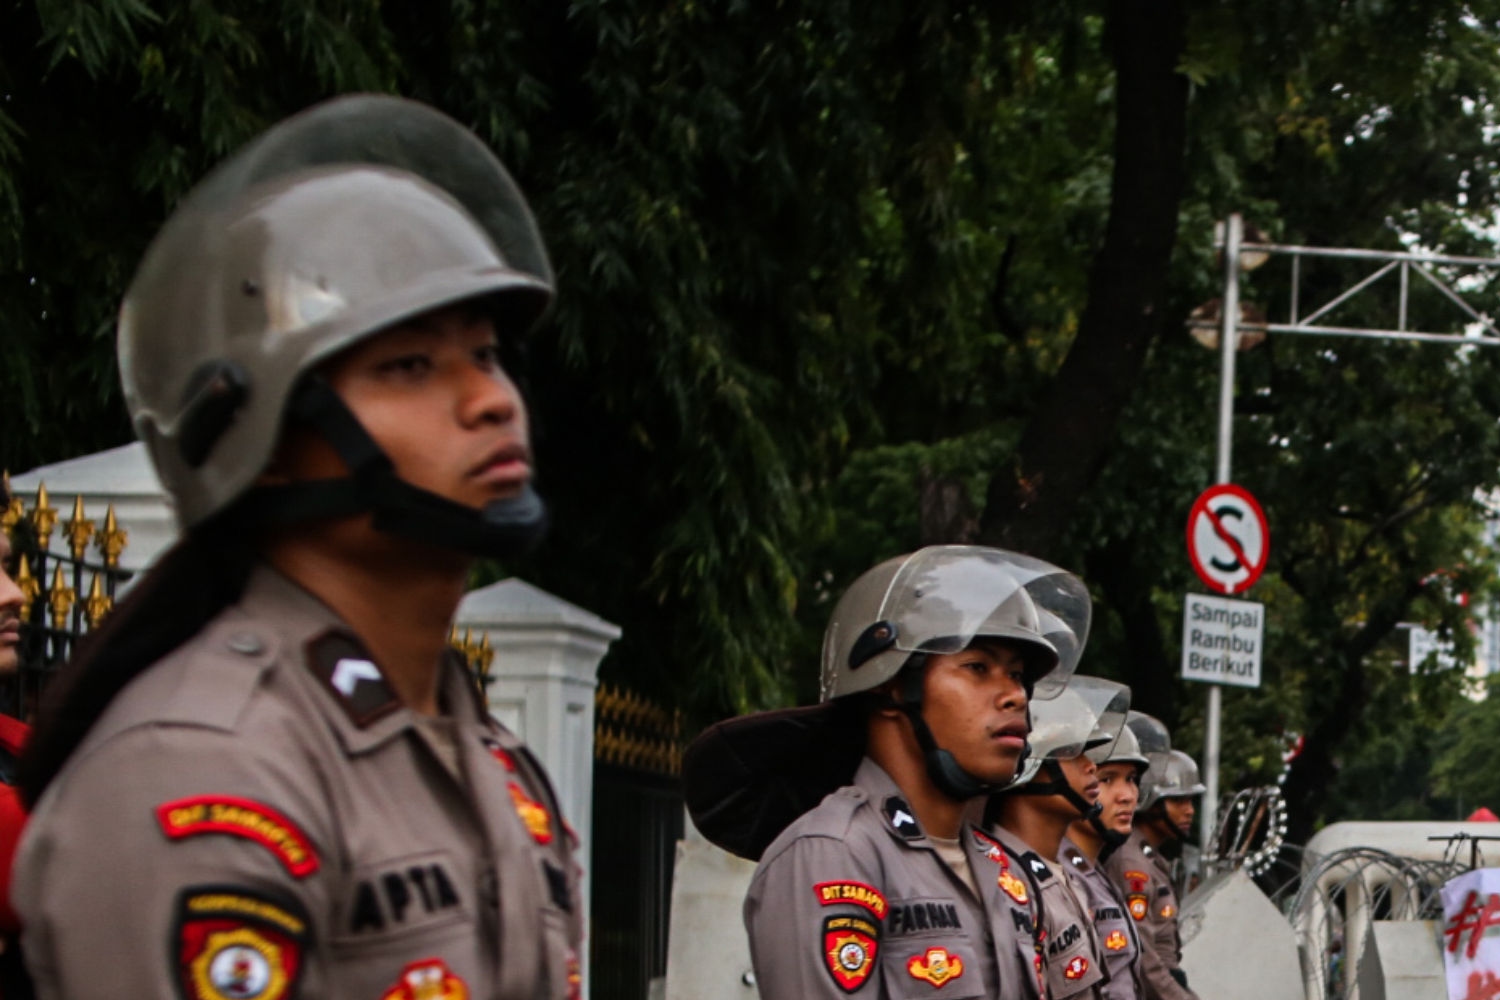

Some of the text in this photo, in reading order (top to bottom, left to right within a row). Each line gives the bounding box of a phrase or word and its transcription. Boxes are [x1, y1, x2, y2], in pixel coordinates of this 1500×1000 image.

[1191, 603, 1258, 630] Sampai
[1190, 629, 1255, 654] Rambu
[1188, 653, 1254, 677] Berikut
[888, 902, 962, 933] FARHAN
